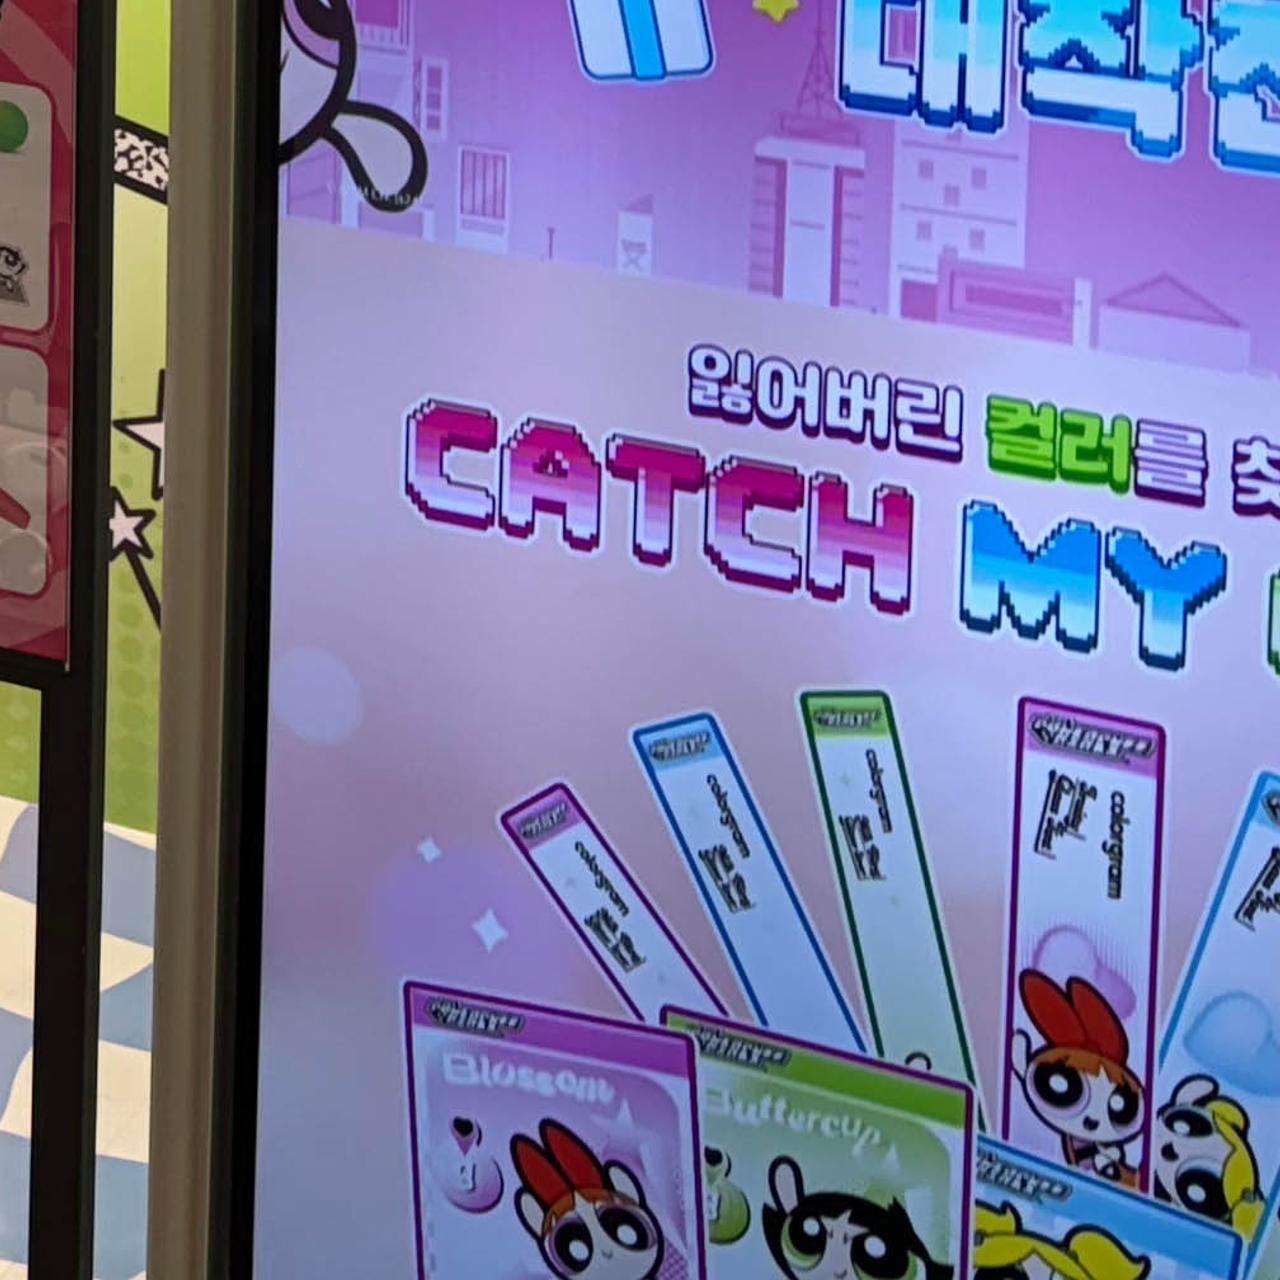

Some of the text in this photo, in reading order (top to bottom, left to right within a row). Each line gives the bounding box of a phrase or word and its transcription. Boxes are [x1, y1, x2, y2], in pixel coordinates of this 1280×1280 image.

[689, 344, 963, 462] 잃어버린
[987, 394, 1207, 508] 컬러를
[405, 400, 1228, 672] CATCH MY
[1105, 790, 1127, 899] colorgram
[441, 1050, 616, 1105] Blossom
